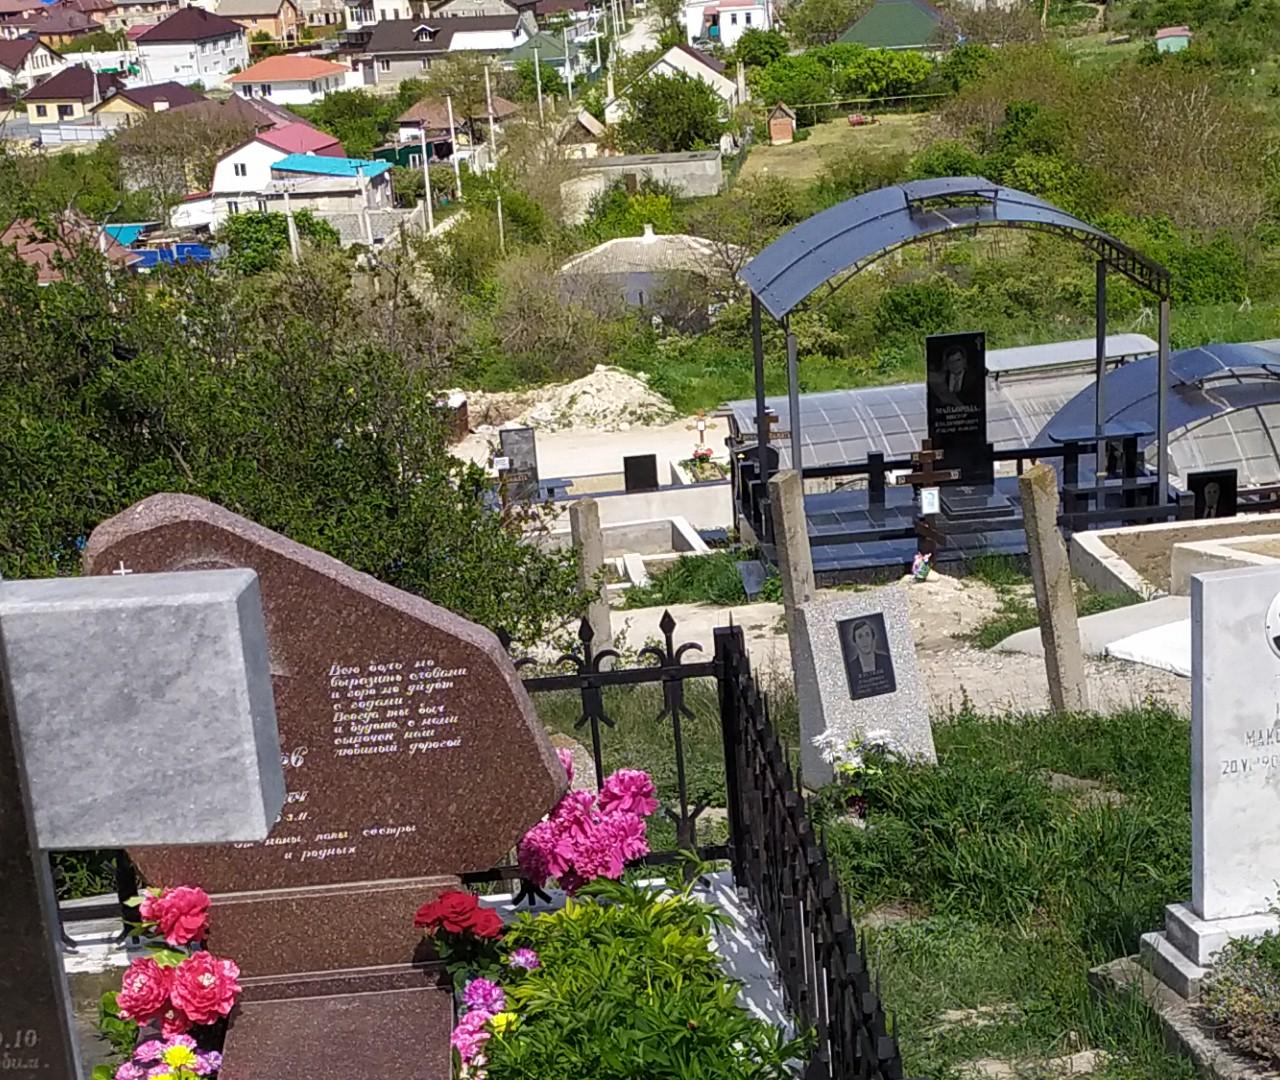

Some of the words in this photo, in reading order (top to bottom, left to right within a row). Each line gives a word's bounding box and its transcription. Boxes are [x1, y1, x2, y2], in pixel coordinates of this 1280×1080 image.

[330, 674, 403, 689] выразить
[331, 690, 341, 699] и
[333, 725, 343, 734] и
[334, 732, 394, 746] сыночек
[409, 735, 462, 755] дорогой
[300, 845, 357, 862] родных
